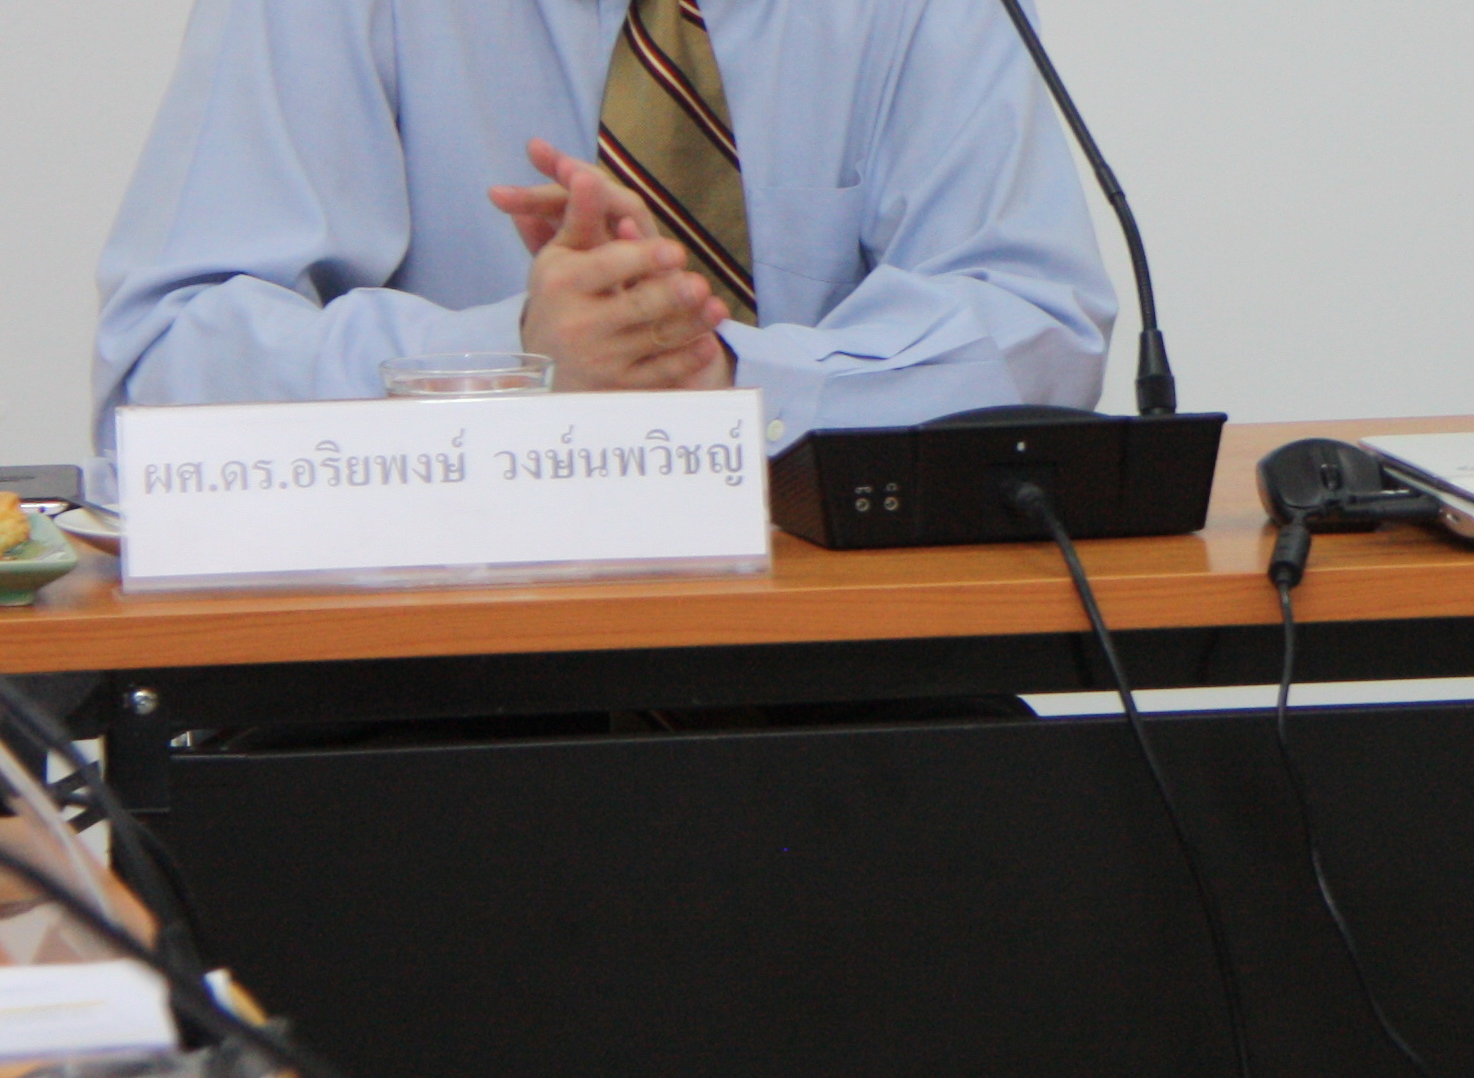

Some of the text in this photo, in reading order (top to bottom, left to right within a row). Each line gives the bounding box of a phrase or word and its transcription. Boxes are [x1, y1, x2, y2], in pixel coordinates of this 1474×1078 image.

[143, 418, 744, 495] ผศ.ดร.อริยพงษ์ วงษ์นพวิชญ์
